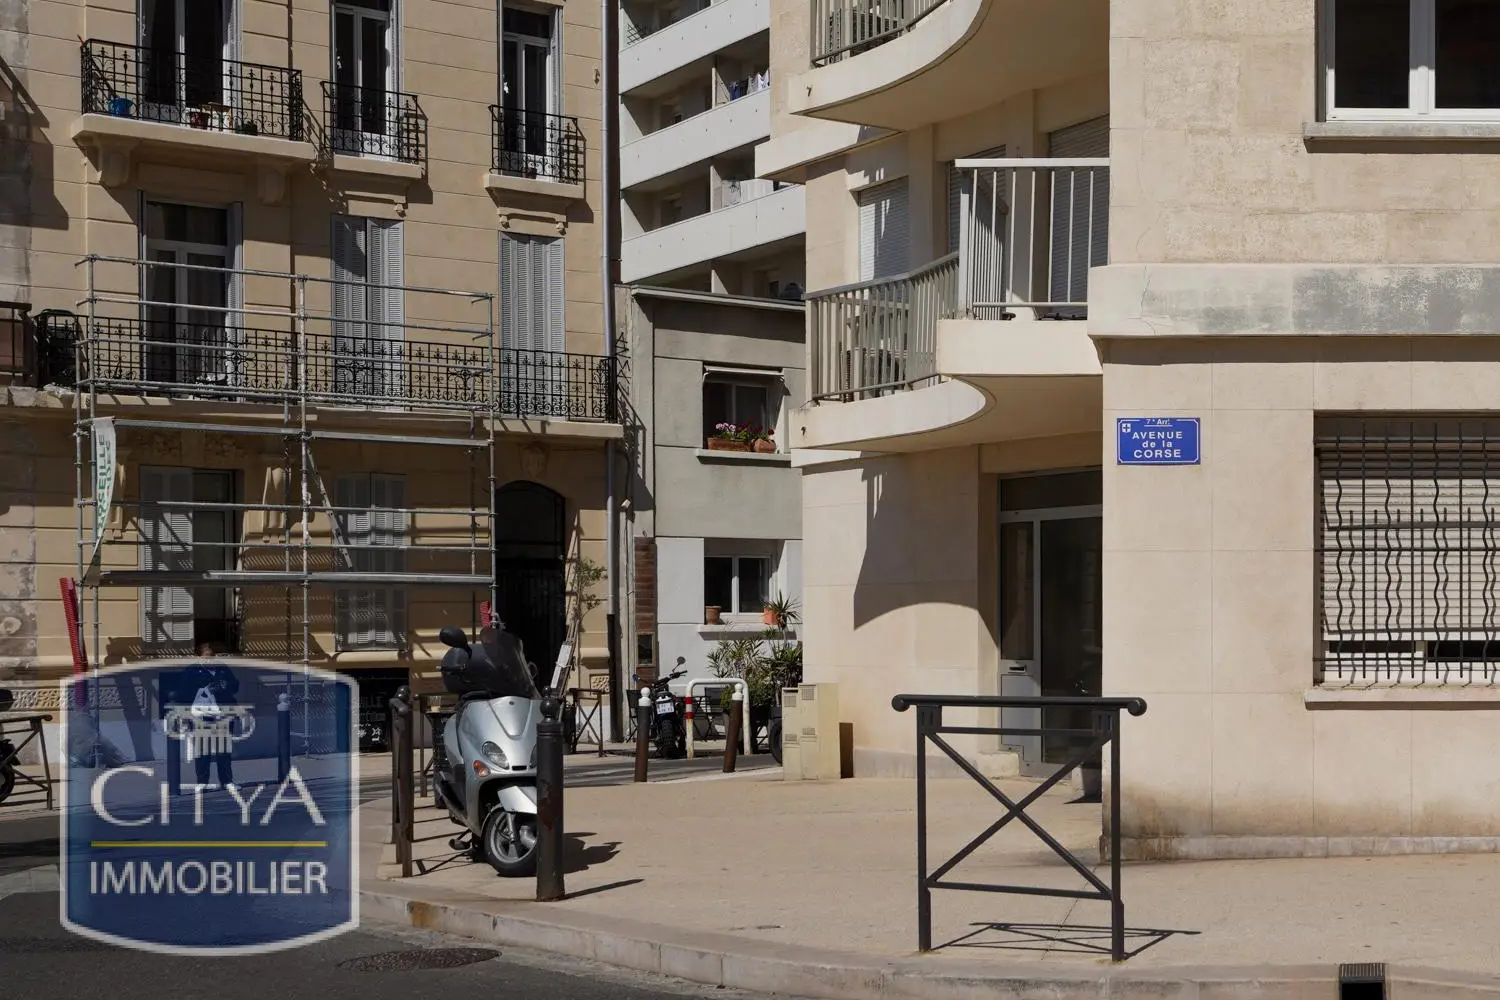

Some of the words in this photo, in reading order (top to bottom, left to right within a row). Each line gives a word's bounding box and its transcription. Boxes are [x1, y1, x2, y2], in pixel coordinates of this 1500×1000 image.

[1132, 431, 1183, 439] AVENUE
[1142, 440, 1156, 448] de
[1162, 440, 1173, 448] la
[1133, 449, 1181, 458] CORSE
